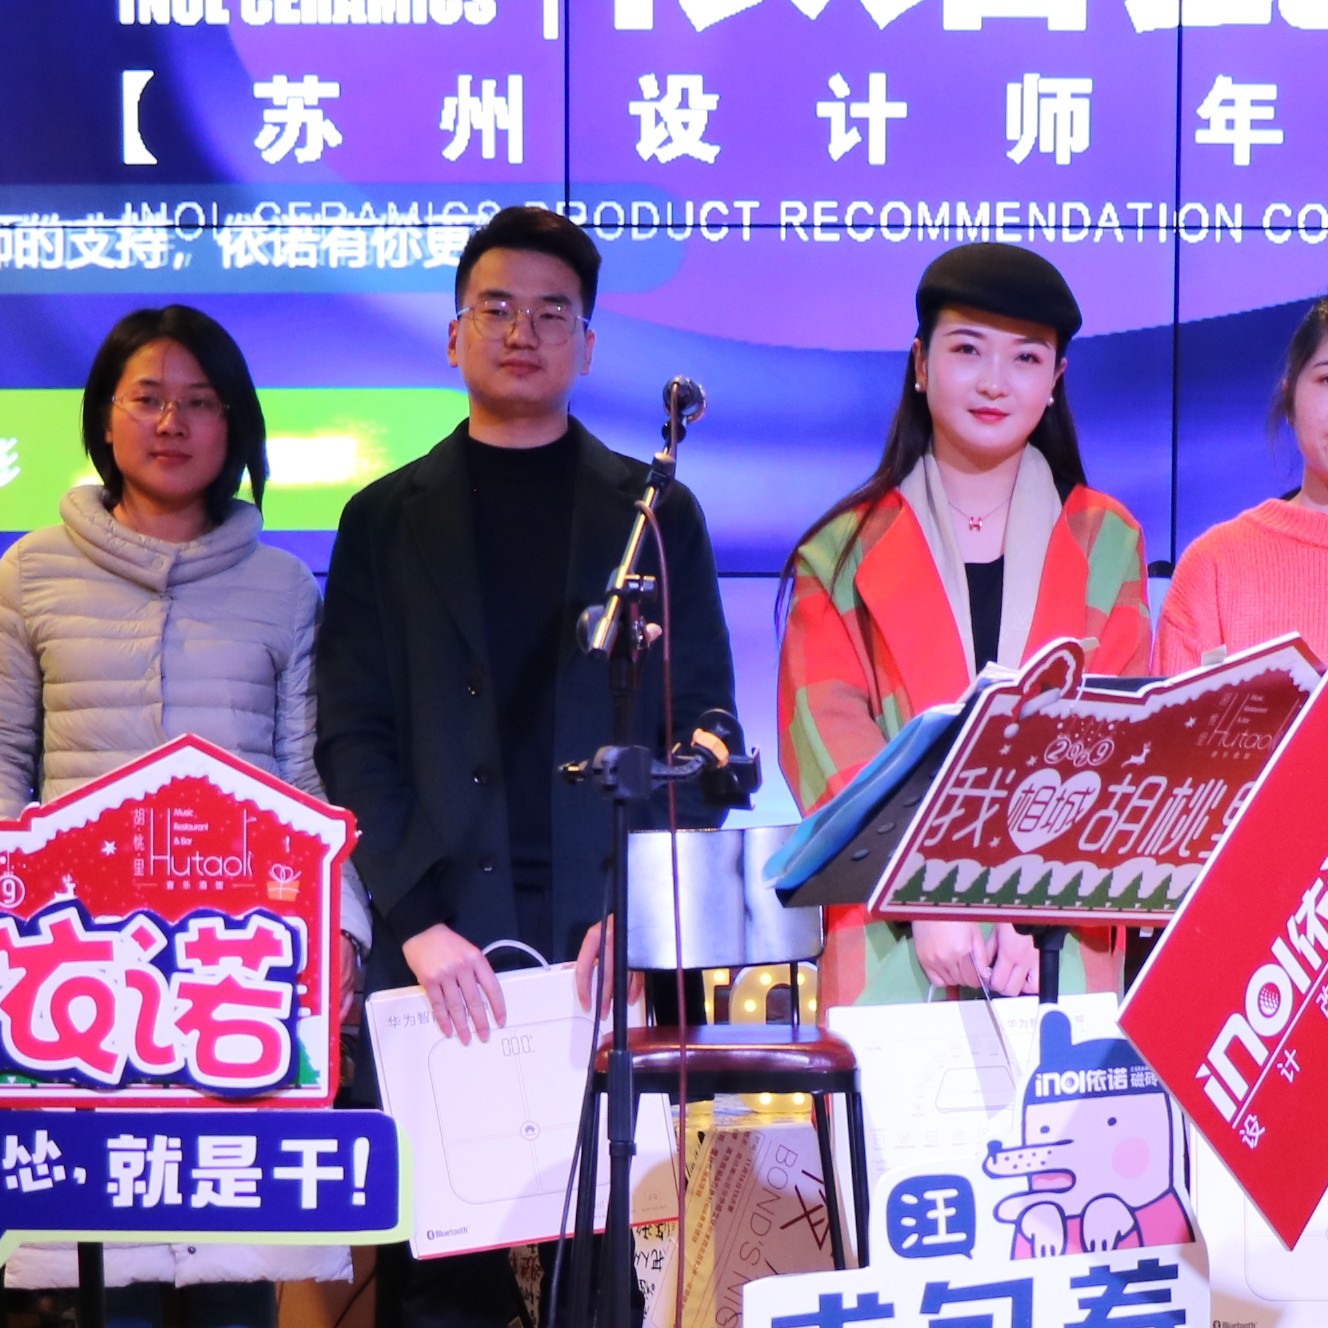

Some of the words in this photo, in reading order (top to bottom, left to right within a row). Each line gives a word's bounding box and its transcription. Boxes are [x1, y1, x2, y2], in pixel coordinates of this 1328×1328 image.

[780, 201, 1242, 245] RECOMMENDATION
[1206, 692, 1300, 751] Hutaol
[898, 1190, 969, 1249] 汪
